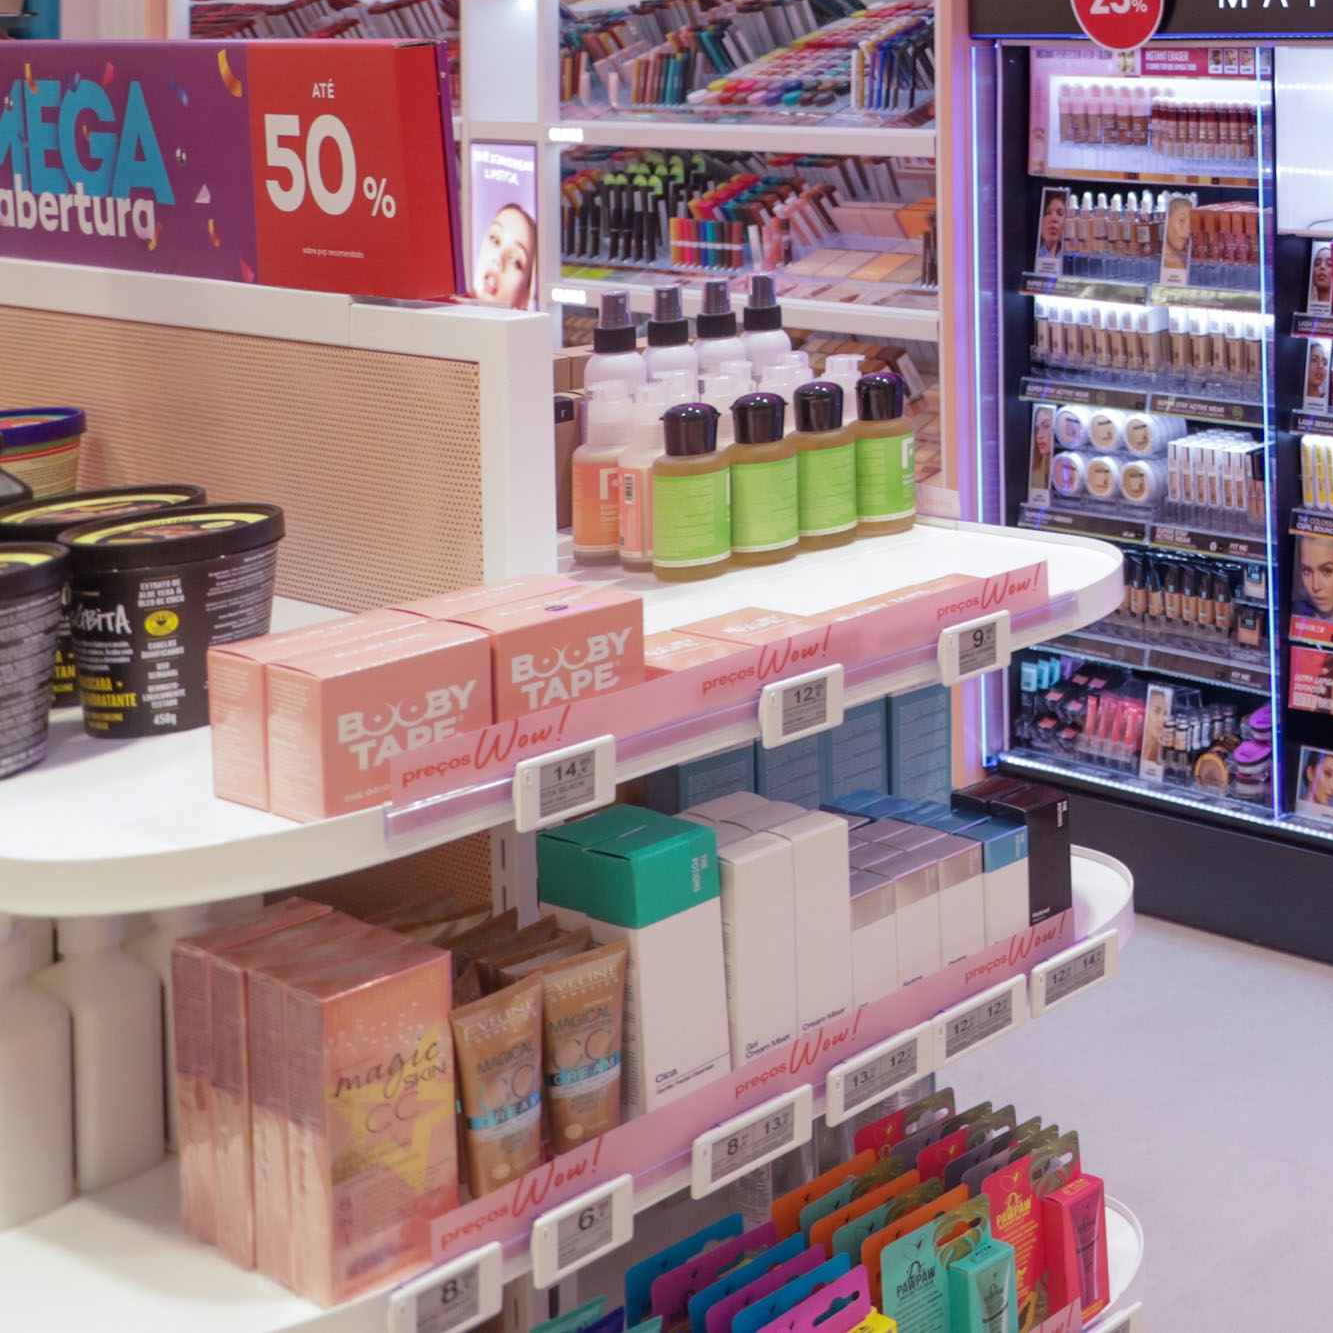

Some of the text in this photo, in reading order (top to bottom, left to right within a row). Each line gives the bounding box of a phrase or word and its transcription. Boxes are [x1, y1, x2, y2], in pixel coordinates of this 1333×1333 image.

[312, 82, 335, 99] ATÉ
[264, 114, 397, 219] 50%
[140, 580, 171, 591] EXTRATO
[937, 595, 979, 620] preços
[981, 561, 1041, 609] Wow!
[511, 626, 632, 683] BOOBY
[703, 666, 755, 695] preços
[757, 625, 831, 681] Wow!
[338, 680, 477, 744] BOOBY
[521, 661, 620, 710] TAPE
[402, 704, 570, 789] preços Wow!
[964, 953, 1007, 984] preços
[1009, 911, 1066, 966] Wow!
[550, 1006, 612, 1034] MAGICAL
[334, 1039, 440, 1100] magic
[403, 1064, 447, 1091] SKIN
[477, 1041, 533, 1074] MAGICAL
[655, 1068, 678, 1084] Cica
[735, 1008, 862, 1100] preços Wow!
[441, 1204, 509, 1250] preços
[512, 1133, 604, 1217] Wow!
[996, 1199, 1033, 1228] PAWPAW
[896, 1265, 936, 1299] PAWPAW
